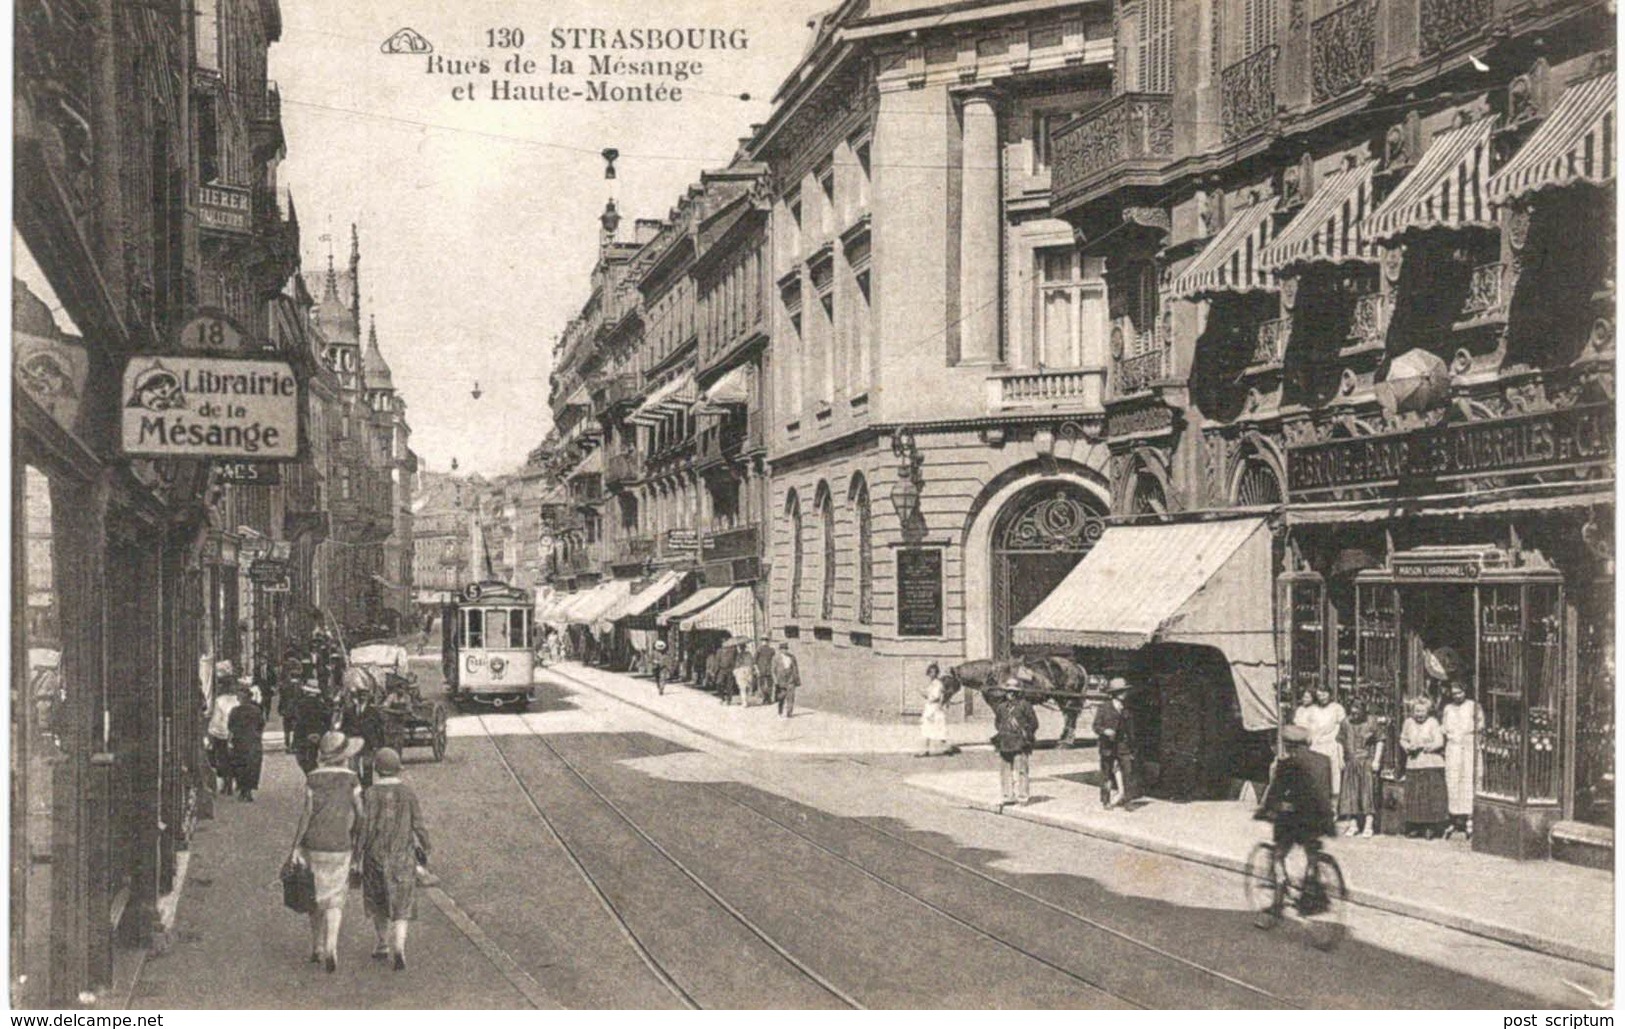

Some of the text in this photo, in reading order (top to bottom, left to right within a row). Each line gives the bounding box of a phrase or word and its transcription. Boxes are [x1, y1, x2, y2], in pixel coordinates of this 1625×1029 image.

[198, 322, 225, 345] 18
[182, 371, 296, 397] Librairie
[198, 402, 247, 418] de la
[138, 415, 280, 453] Mésange
[469, 585, 477, 595] 5
